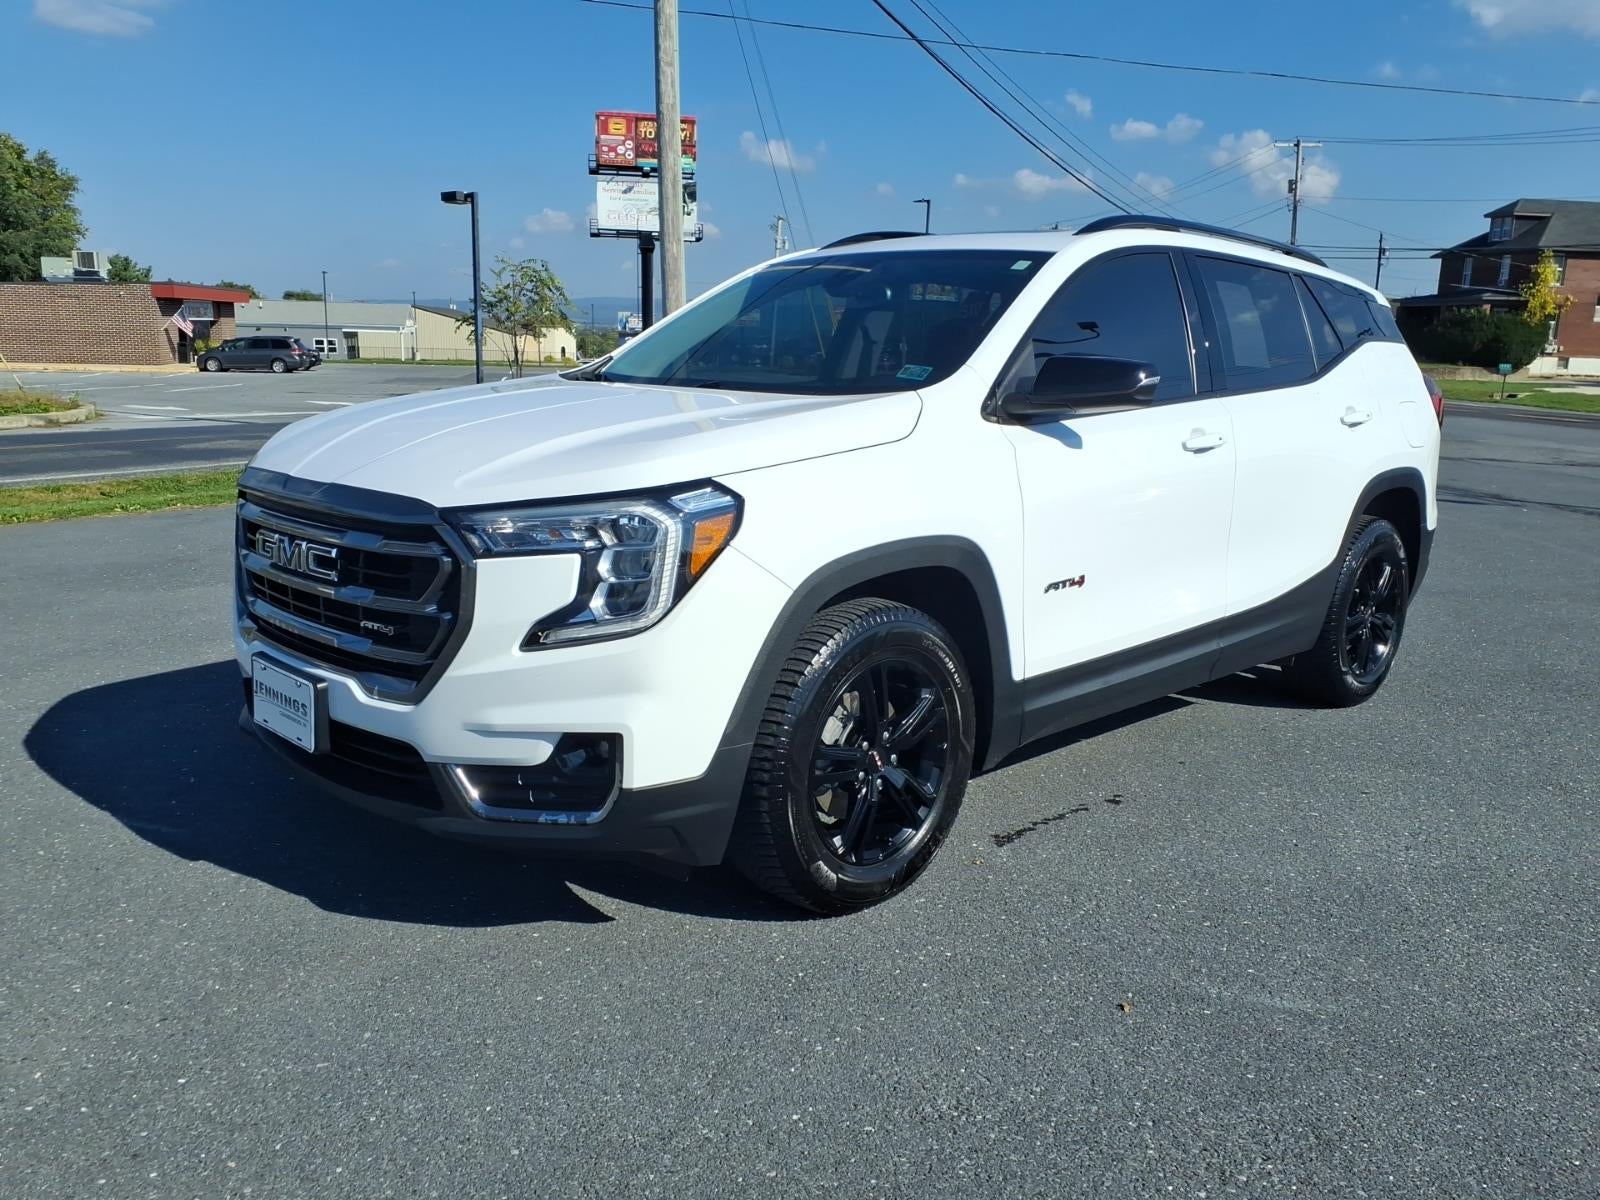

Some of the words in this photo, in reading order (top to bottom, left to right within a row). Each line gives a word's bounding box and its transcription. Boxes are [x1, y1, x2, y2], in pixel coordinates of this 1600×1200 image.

[256, 529, 339, 582] GMC
[1043, 574, 1086, 594] AT4
[360, 620, 394, 636] AT4
[254, 679, 308, 718] JENNINGS
